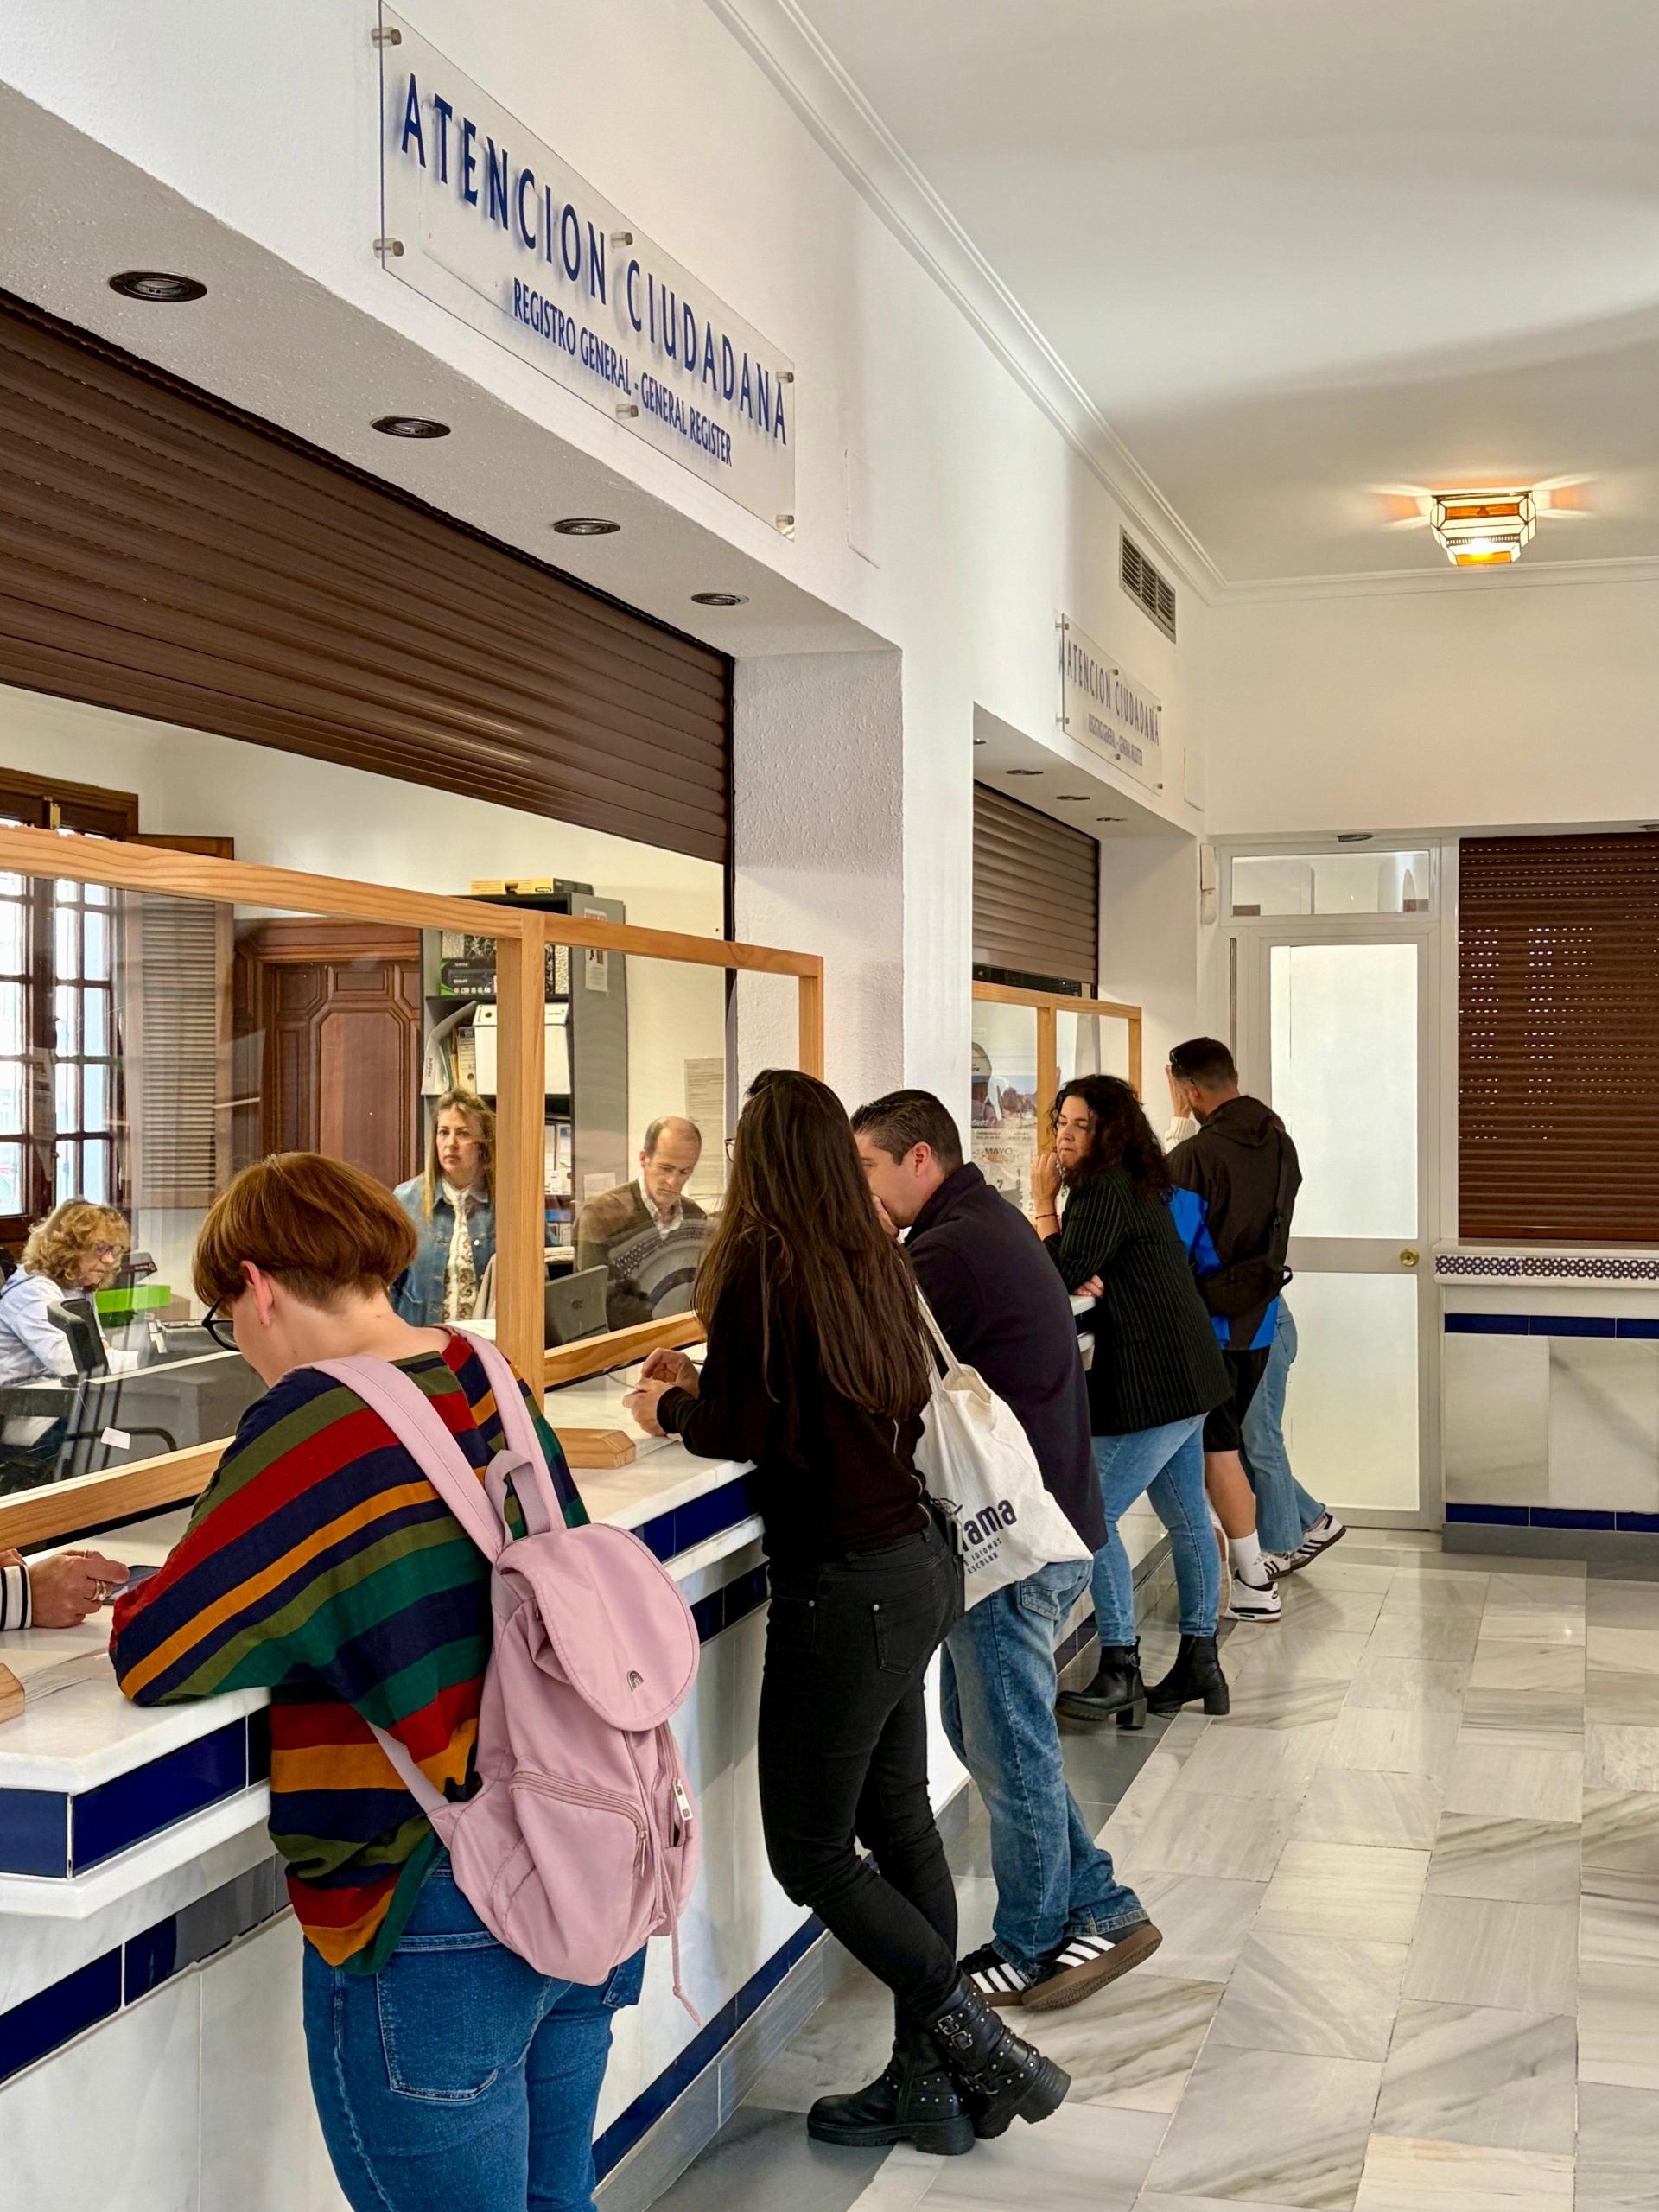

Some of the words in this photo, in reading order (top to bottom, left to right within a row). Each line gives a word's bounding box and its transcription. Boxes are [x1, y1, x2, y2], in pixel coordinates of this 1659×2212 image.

[401, 73, 607, 306] ATENCION
[626, 260, 787, 446] CIUDADANA
[513, 276, 576, 356] REGISTRO
[581, 327, 631, 396] GENERAL
[642, 372, 688, 436] GENERAL
[690, 409, 732, 467] REGISTER
[1067, 639, 1111, 709] ATENCION
[1115, 681, 1159, 746] CIUDADANA
[997, 1179, 1003, 1189] 7
[971, 1538, 1002, 1561] IDIOMAS
